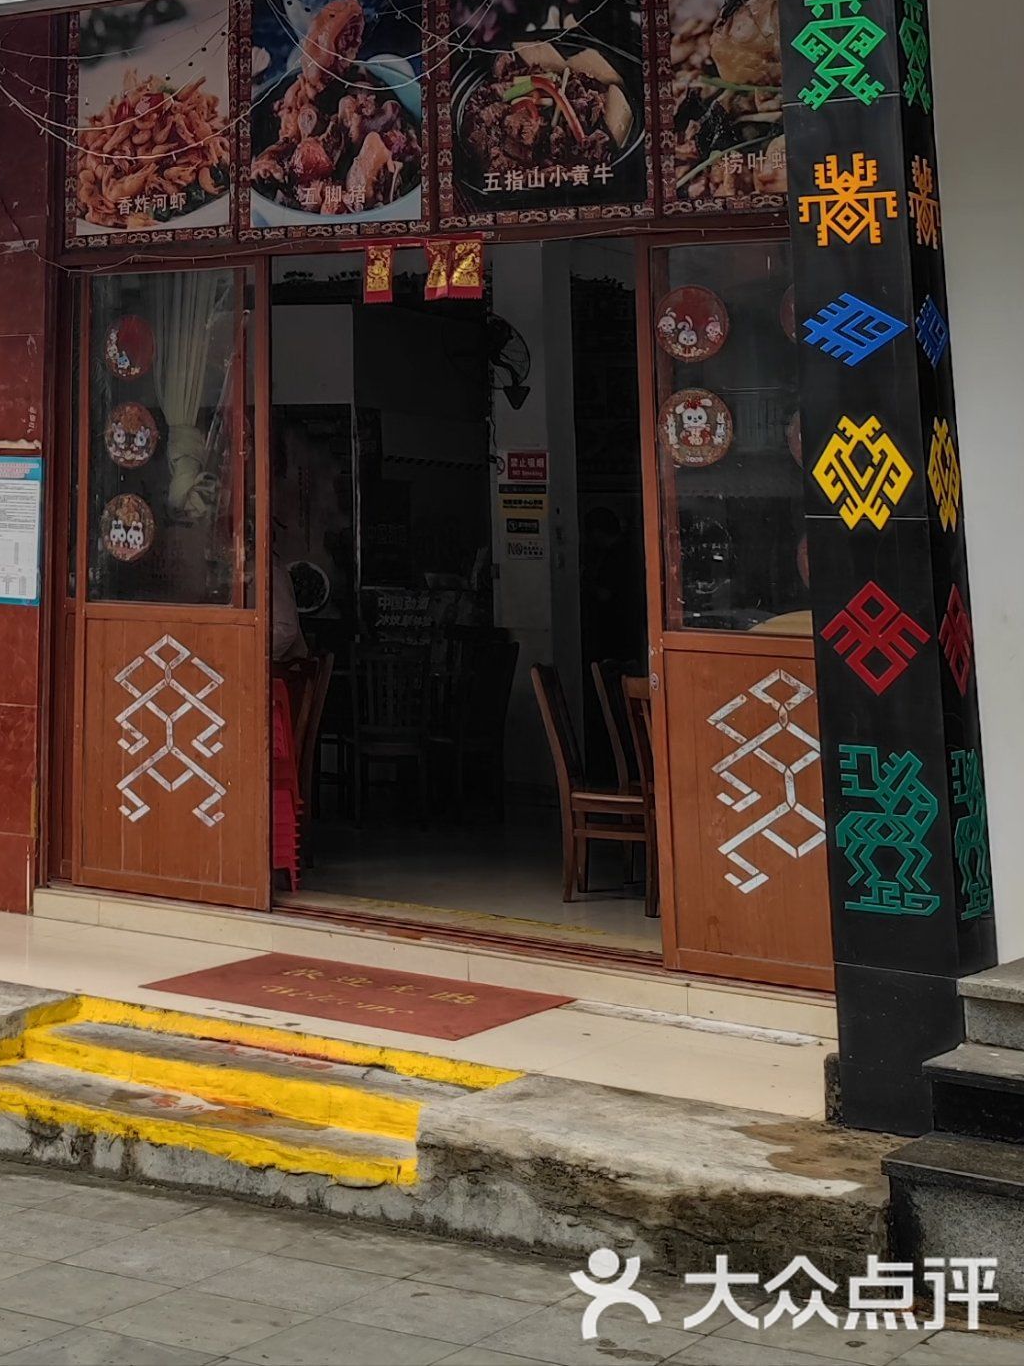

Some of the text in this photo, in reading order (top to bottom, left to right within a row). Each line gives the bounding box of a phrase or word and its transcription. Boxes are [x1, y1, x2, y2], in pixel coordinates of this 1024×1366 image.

[482, 161, 615, 193] 五指山小黄牛
[117, 192, 187, 216] 香炸河虾
[301, 184, 366, 207] 五脚猪
